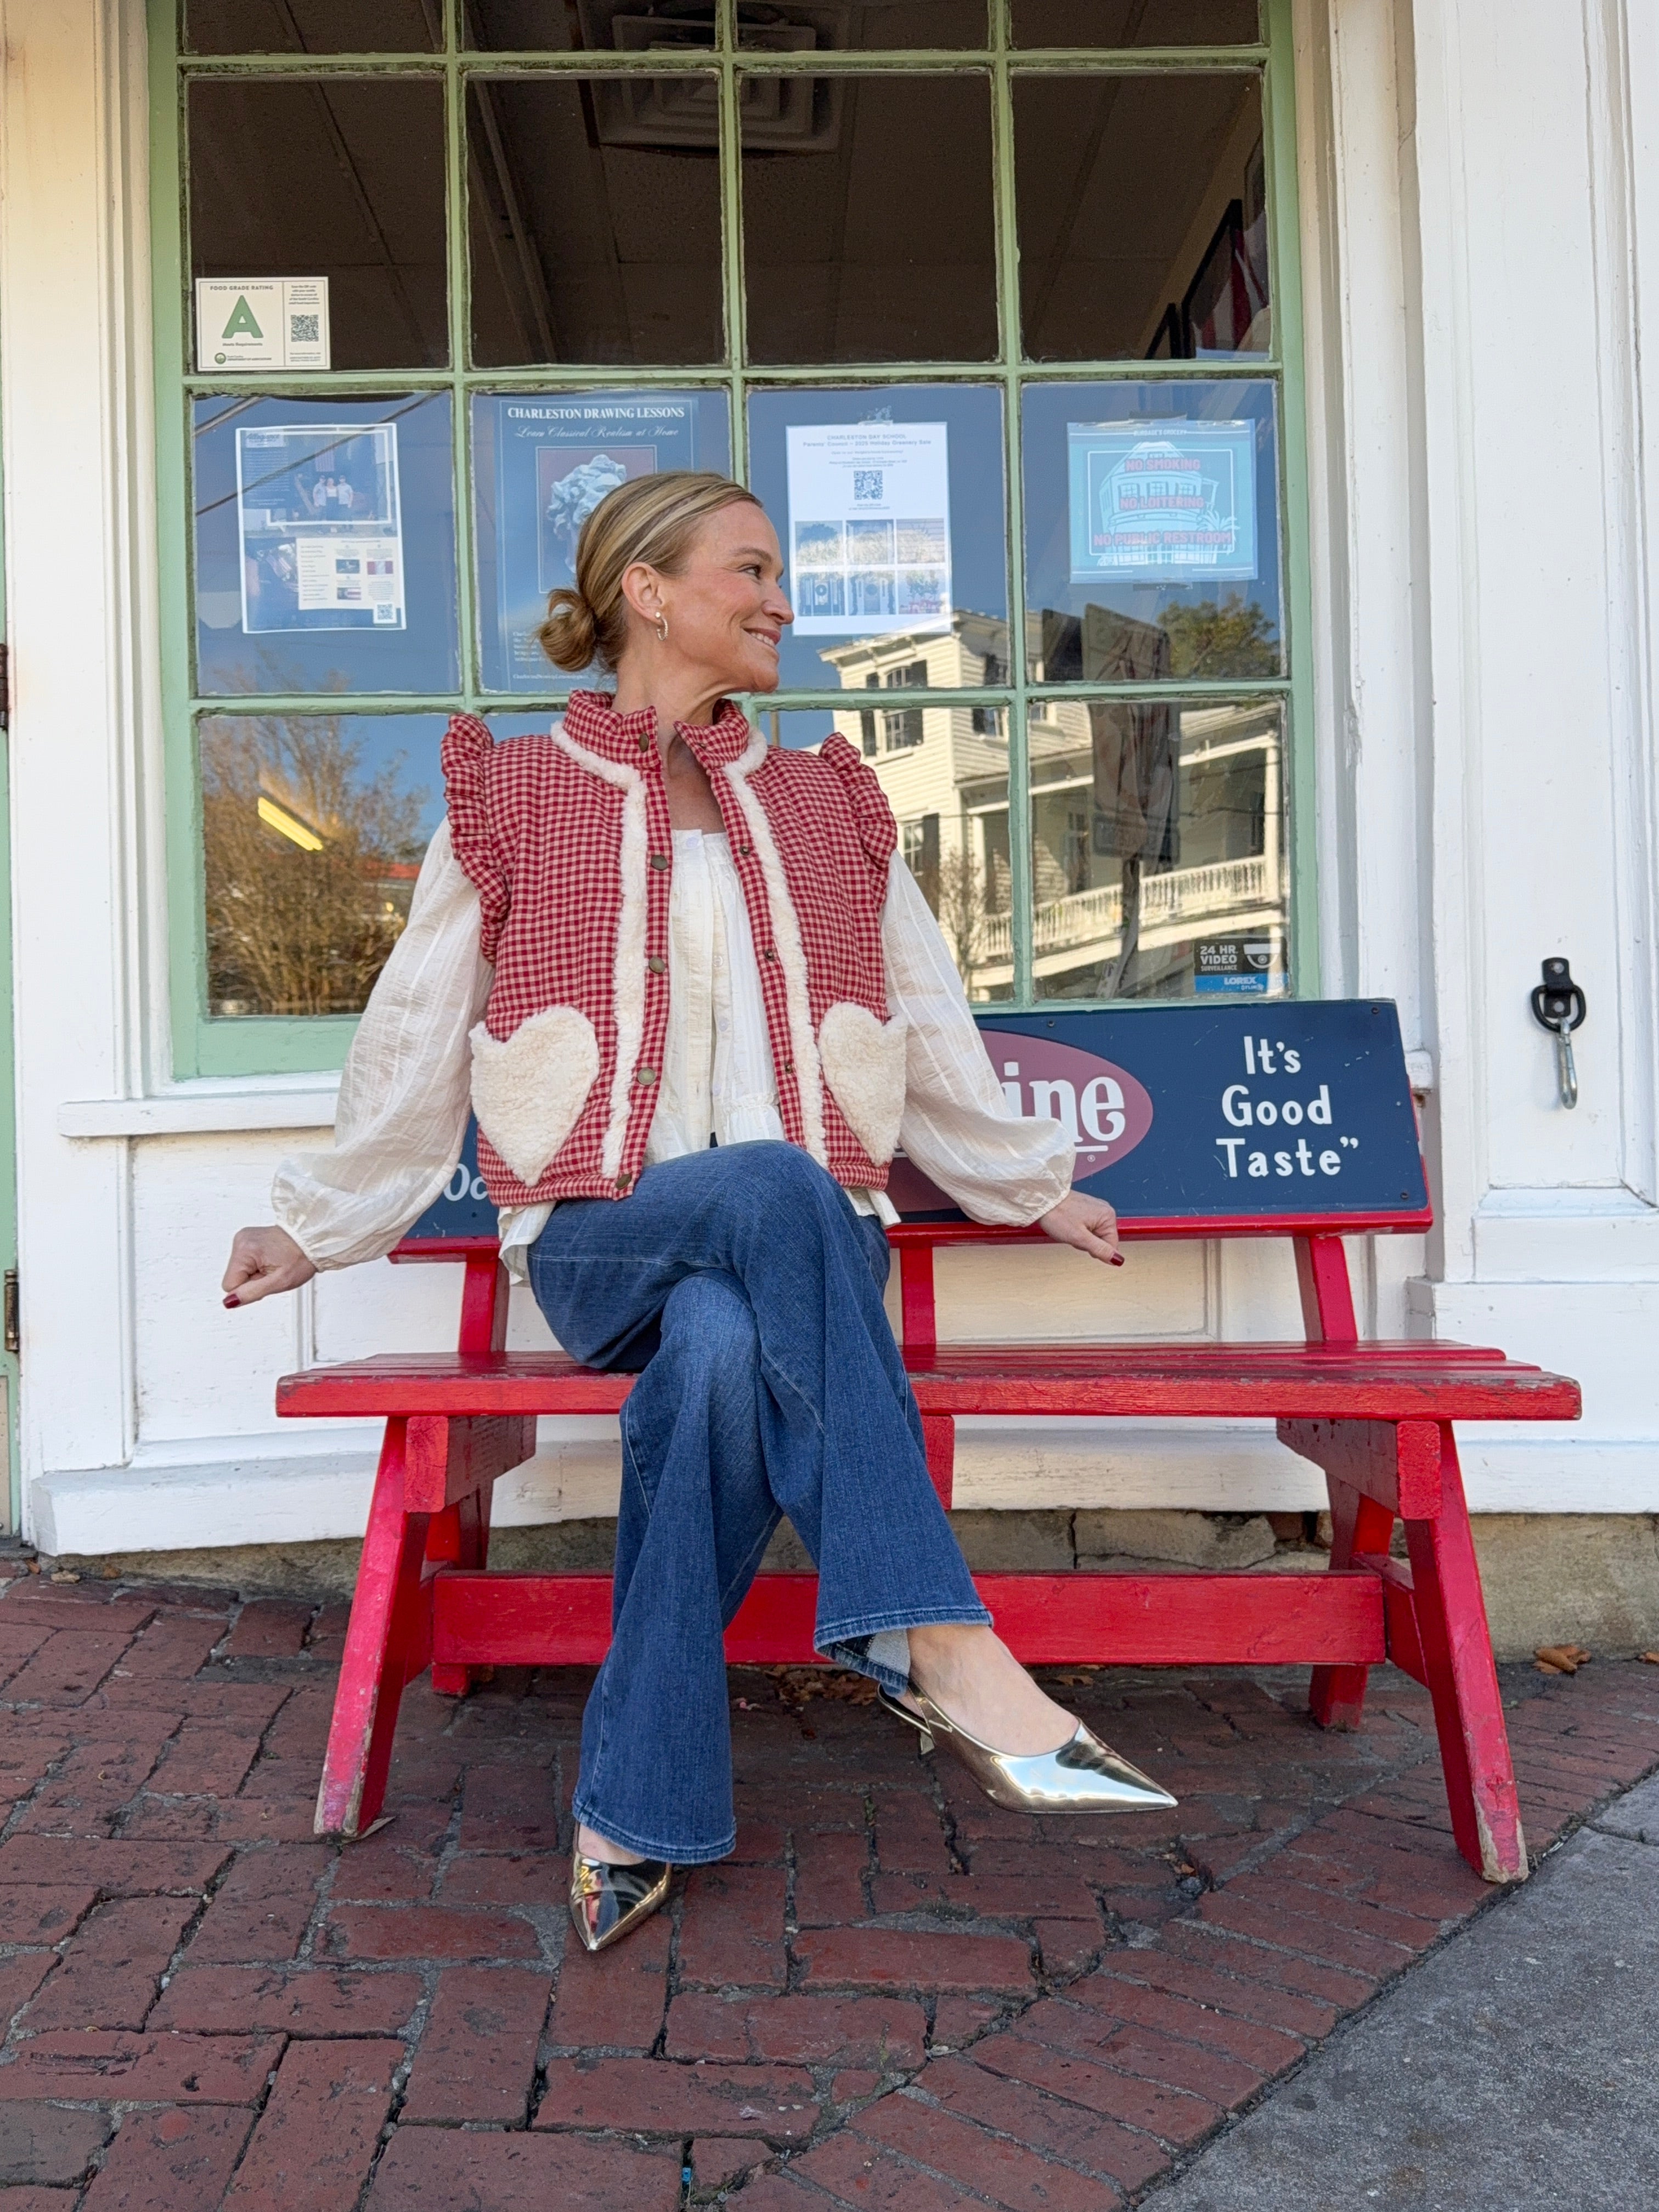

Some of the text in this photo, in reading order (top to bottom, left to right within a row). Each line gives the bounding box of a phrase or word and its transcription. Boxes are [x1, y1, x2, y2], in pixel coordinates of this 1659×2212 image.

[222, 295, 264, 338] A
[507, 407, 685, 419] CHARLESTON DRAWING LESSONS
[516, 425, 679, 437] Learn Classical Realism at Home
[1126, 458, 1200, 471] NO SMOKING
[1120, 496, 1205, 510] NO LOITERING
[1094, 531, 1232, 546] NO PUBLIC RESTROOM
[1200, 946, 1216, 955] 24
[1200, 955, 1237, 964] VIDEO
[1223, 977, 1257, 985] LOREX
[1001, 1061, 1126, 1142] ine
[1222, 1084, 1333, 1127] Good
[443, 1163, 488, 1201] Oc
